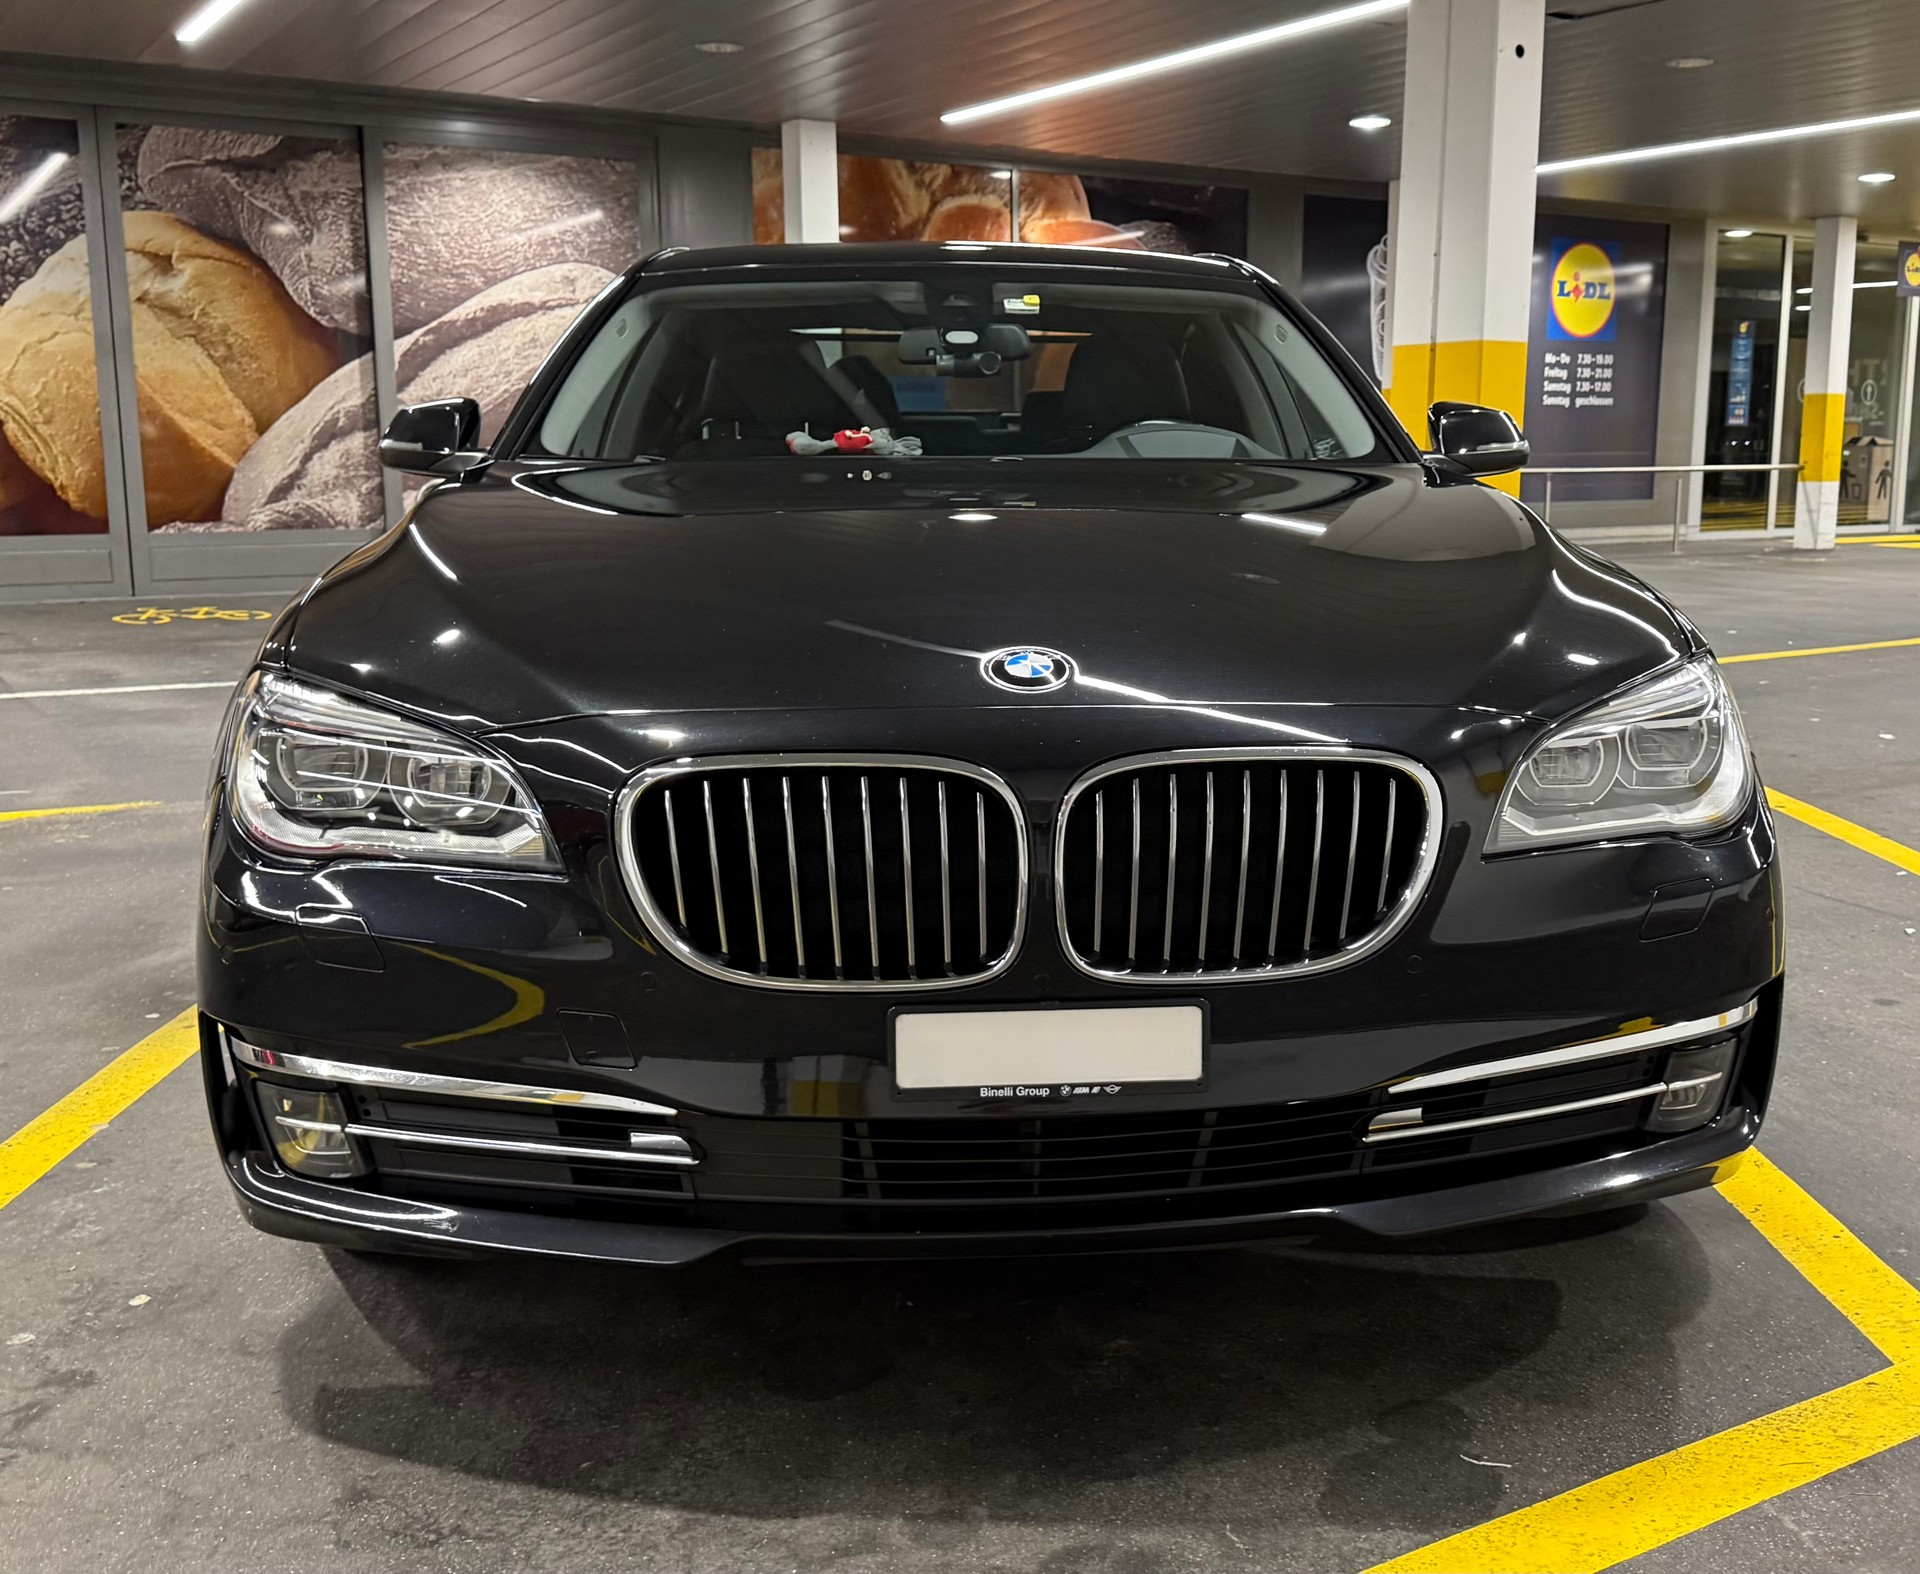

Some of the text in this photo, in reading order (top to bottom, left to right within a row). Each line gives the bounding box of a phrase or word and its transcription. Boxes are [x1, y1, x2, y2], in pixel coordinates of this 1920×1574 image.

[1544, 366, 1568, 380] Freitag
[1543, 380, 1571, 394] Samstag
[1575, 395, 1613, 408] geschlossen
[980, 1087, 1013, 1097] Binelli
[1016, 1086, 1050, 1097] Group
